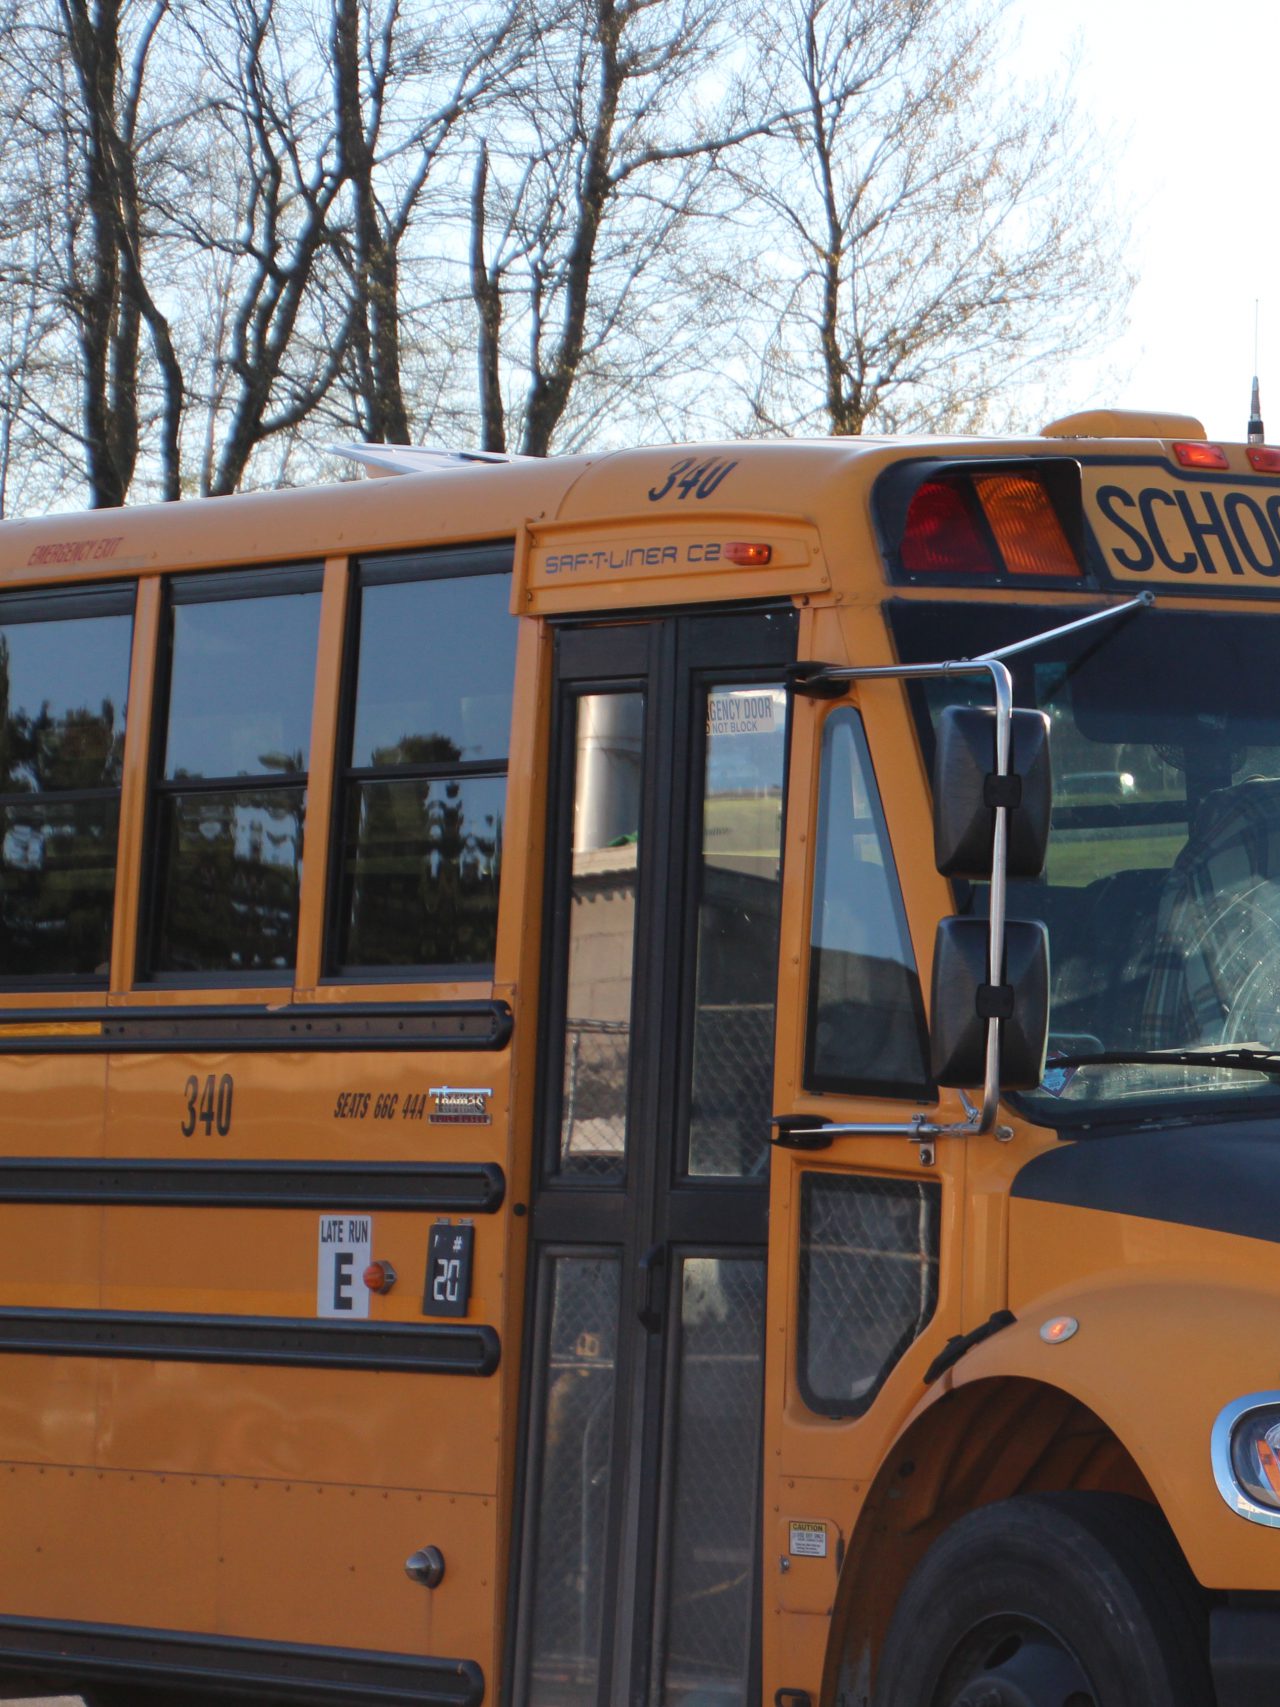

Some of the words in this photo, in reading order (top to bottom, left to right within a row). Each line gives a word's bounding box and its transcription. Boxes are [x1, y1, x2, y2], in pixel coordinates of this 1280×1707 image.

[648, 456, 739, 501] 340
[687, 543, 721, 562] C2
[707, 699, 740, 722] GENCY
[743, 697, 772, 719] DOOR
[712, 722, 728, 734] NOT
[730, 720, 758, 733] BLOCK
[181, 1073, 234, 1137] 340
[334, 1092, 371, 1119] SEATS
[374, 1093, 398, 1119] 66C
[402, 1093, 427, 1119] 44A
[321, 1220, 344, 1243] LATE
[348, 1220, 369, 1243] RUN
[334, 1252, 353, 1310] E
[433, 1258, 461, 1302] 20
[792, 1523, 823, 1531] CAUTION
